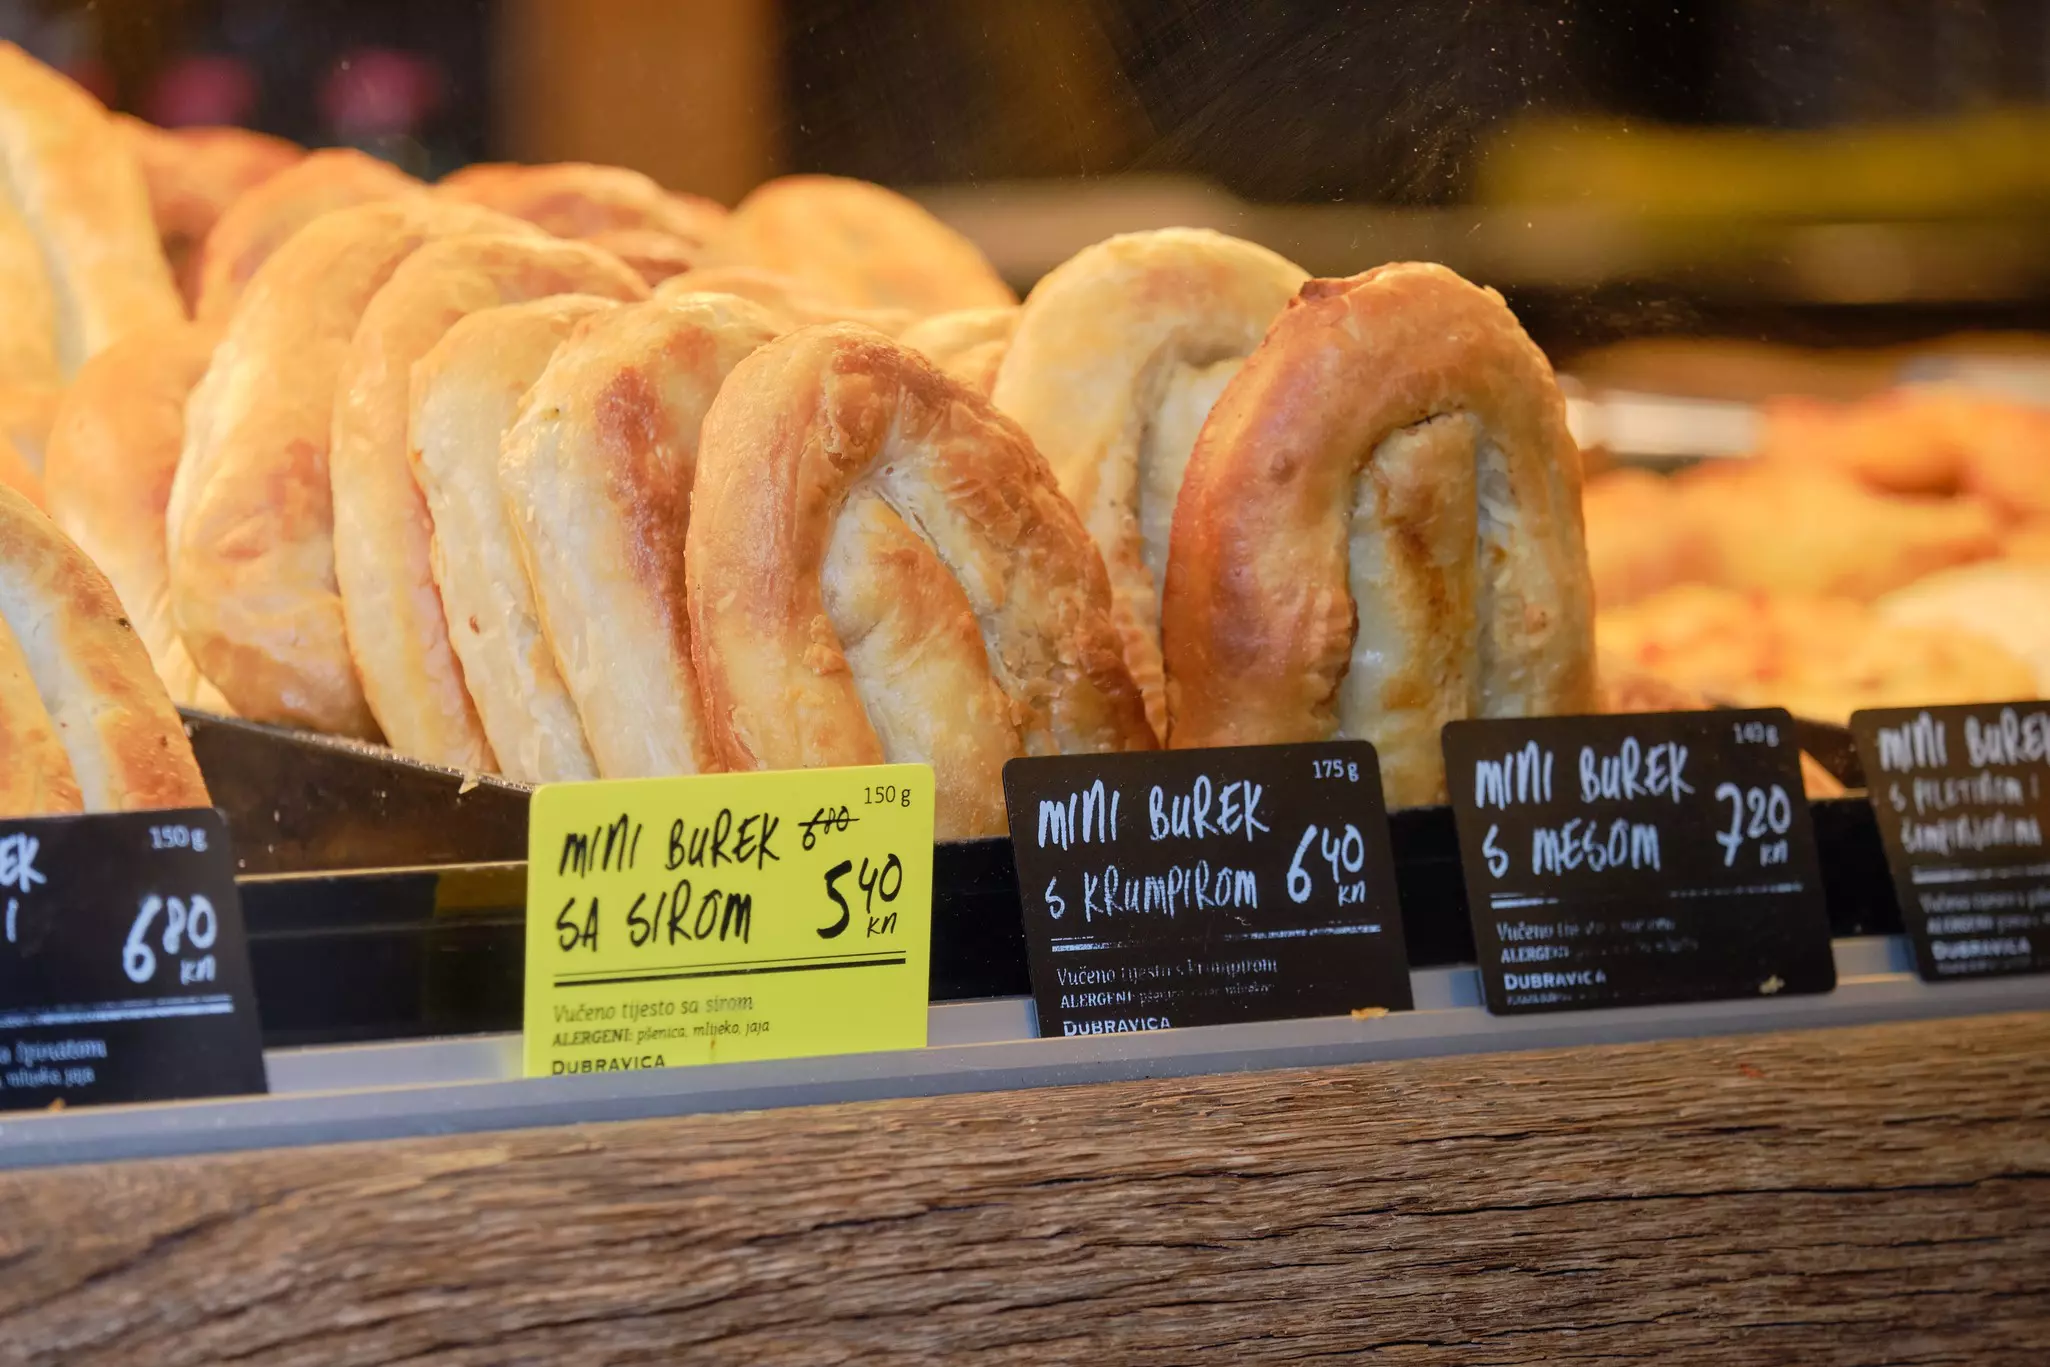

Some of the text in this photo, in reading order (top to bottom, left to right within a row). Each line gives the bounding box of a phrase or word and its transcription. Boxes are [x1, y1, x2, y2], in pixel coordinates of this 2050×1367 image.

[1877, 706, 2050, 774] MINI BURE
[1312, 760, 1359, 782] 175 g
[1475, 736, 1695, 810] MINI BUREK
[864, 785, 911, 808] 150 g
[1038, 775, 1270, 850] MINI BUREK
[149, 825, 208, 852] 150 g
[558, 808, 780, 878] MINI BUREK
[1482, 817, 1661, 878] S MESOM
[1045, 860, 1258, 922] S KRUMPIROM
[556, 879, 752, 951] SA SIROM
[1057, 965, 1115, 986] Vučeno
[1503, 969, 1606, 991] DUBRAVICA
[553, 996, 753, 1023] Vučeno tijesto sa sirom
[552, 1028, 632, 1047] ALERGENI:
[745, 1020, 770, 1036] jaja
[1063, 1017, 1171, 1037] DUBRAVICA
[552, 1055, 665, 1075] DUBRAVICA
